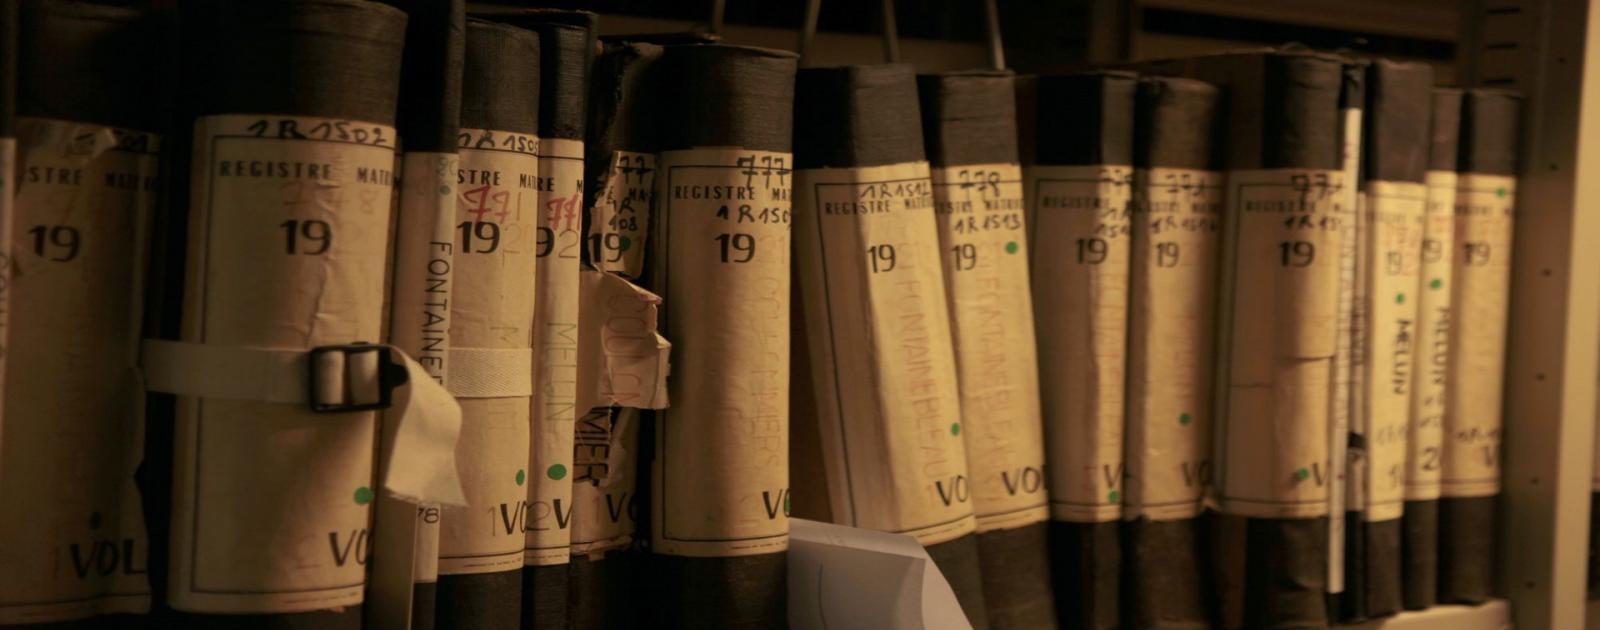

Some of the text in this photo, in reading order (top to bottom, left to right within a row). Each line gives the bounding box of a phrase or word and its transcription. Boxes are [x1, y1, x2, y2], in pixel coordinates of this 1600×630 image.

[219, 160, 332, 180] REGISTRE
[457, 168, 501, 186] STRE
[674, 185, 755, 200] REGISTRE
[825, 200, 891, 216] REGISTRE
[28, 225, 80, 262] 19
[280, 219, 332, 256] 19
[456, 221, 500, 254] 19
[588, 231, 626, 263] 19
[714, 233, 755, 263] 19
[1075, 237, 1108, 264] 19
[868, 243, 895, 274] 19
[951, 243, 977, 271] 19
[1156, 241, 1180, 268] 19
[1278, 240, 1315, 268] 19
[1464, 242, 1492, 267] 19
[1392, 317, 1413, 396] MELUN
[70, 539, 147, 579] VOL
